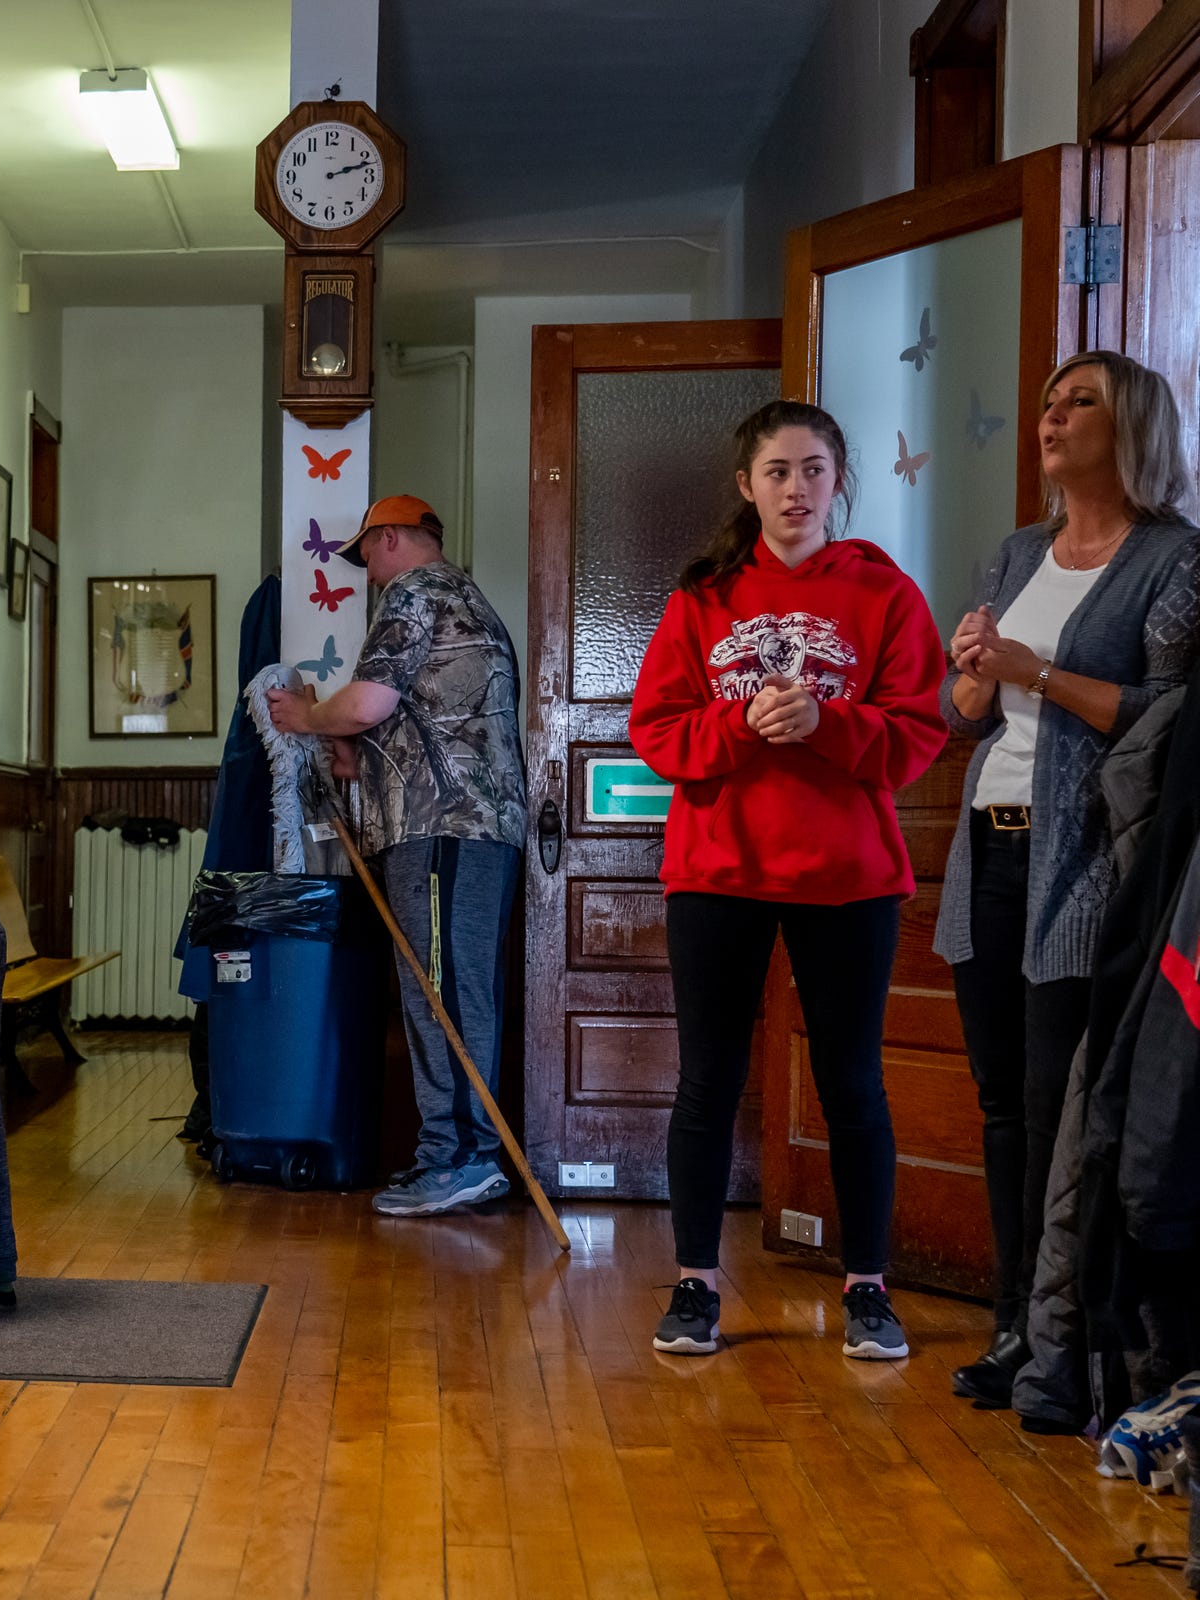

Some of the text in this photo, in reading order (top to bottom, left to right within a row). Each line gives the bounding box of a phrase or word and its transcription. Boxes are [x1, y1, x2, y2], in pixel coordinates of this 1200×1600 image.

[308, 137, 317, 152] 11
[325, 131, 339, 147] 12
[350, 137, 355, 151] 1
[292, 151, 306, 167] 10
[360, 150, 370, 165] 2
[286, 170, 296, 185] 9
[364, 168, 374, 184] 3
[292, 187, 303, 203] 8
[356, 187, 368, 201] 4
[307, 202, 317, 217] 7
[324, 205, 335, 221] 6
[343, 201, 353, 216] 5
[305, 280, 354, 302] REGULATOR
